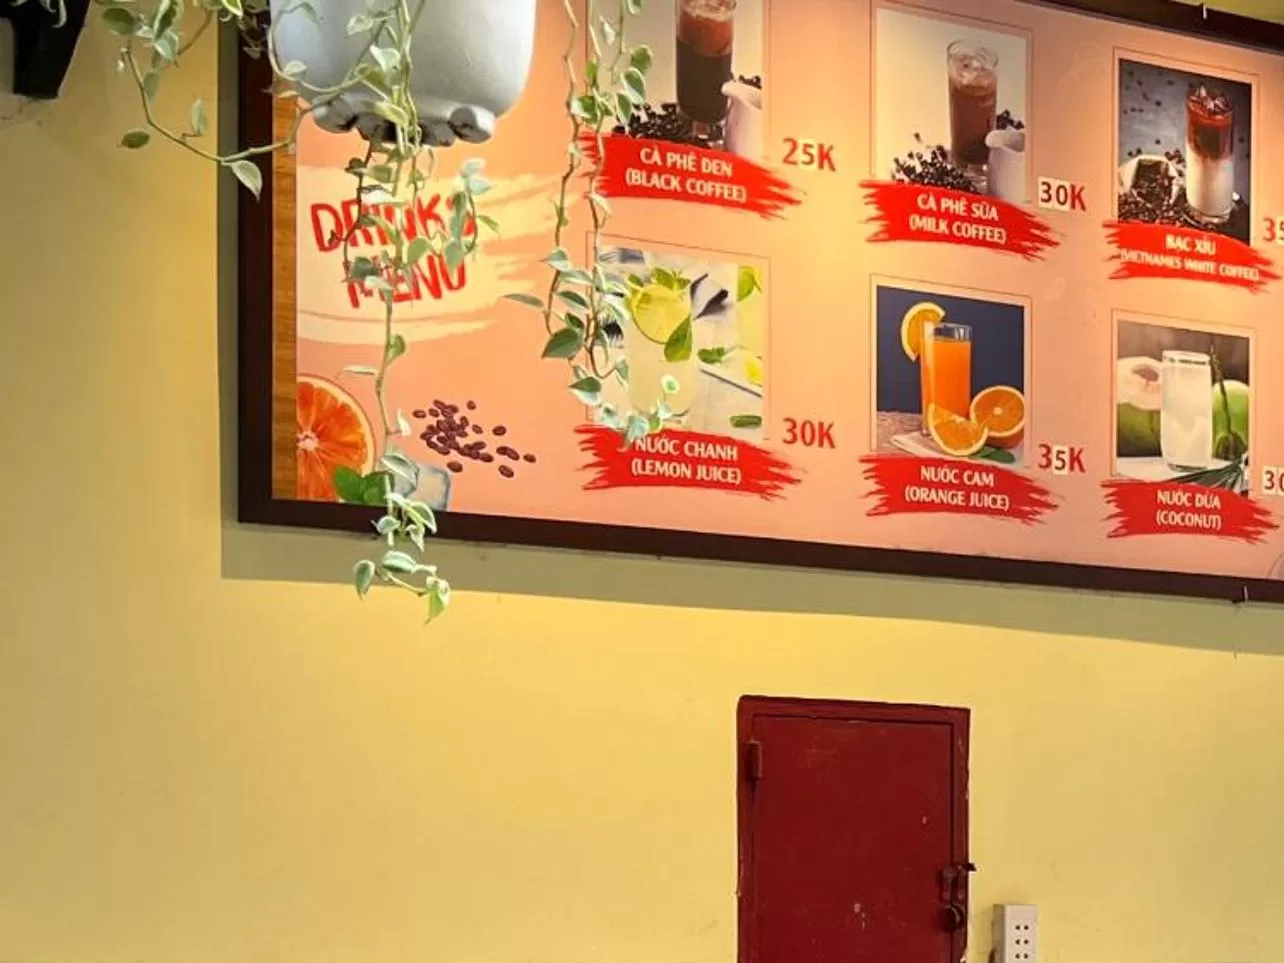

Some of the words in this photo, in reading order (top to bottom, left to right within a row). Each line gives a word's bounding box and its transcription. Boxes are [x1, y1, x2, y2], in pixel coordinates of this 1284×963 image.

[666, 150, 697, 172] PHÊ
[782, 138, 836, 172] 25K
[625, 167, 681, 192] (BLACK
[686, 177, 748, 203] COFFEE)
[1039, 181, 1087, 212] 30K
[941, 197, 968, 217] PHÊ
[908, 213, 949, 234] (MILK
[952, 221, 1007, 245] COFFEE)
[1184, 257, 1217, 275] WHITE
[782, 417, 836, 449] 30K
[683, 440, 738, 461] CHANH
[1037, 443, 1086, 473] 35K
[631, 458, 692, 479] (LEMON
[695, 466, 741, 485] JUICE)
[963, 470, 995, 487] CAM
[904, 484, 966, 506] (ORANGE
[969, 491, 1009, 512] JUICE)
[1155, 509, 1222, 530] (COCONUT)
